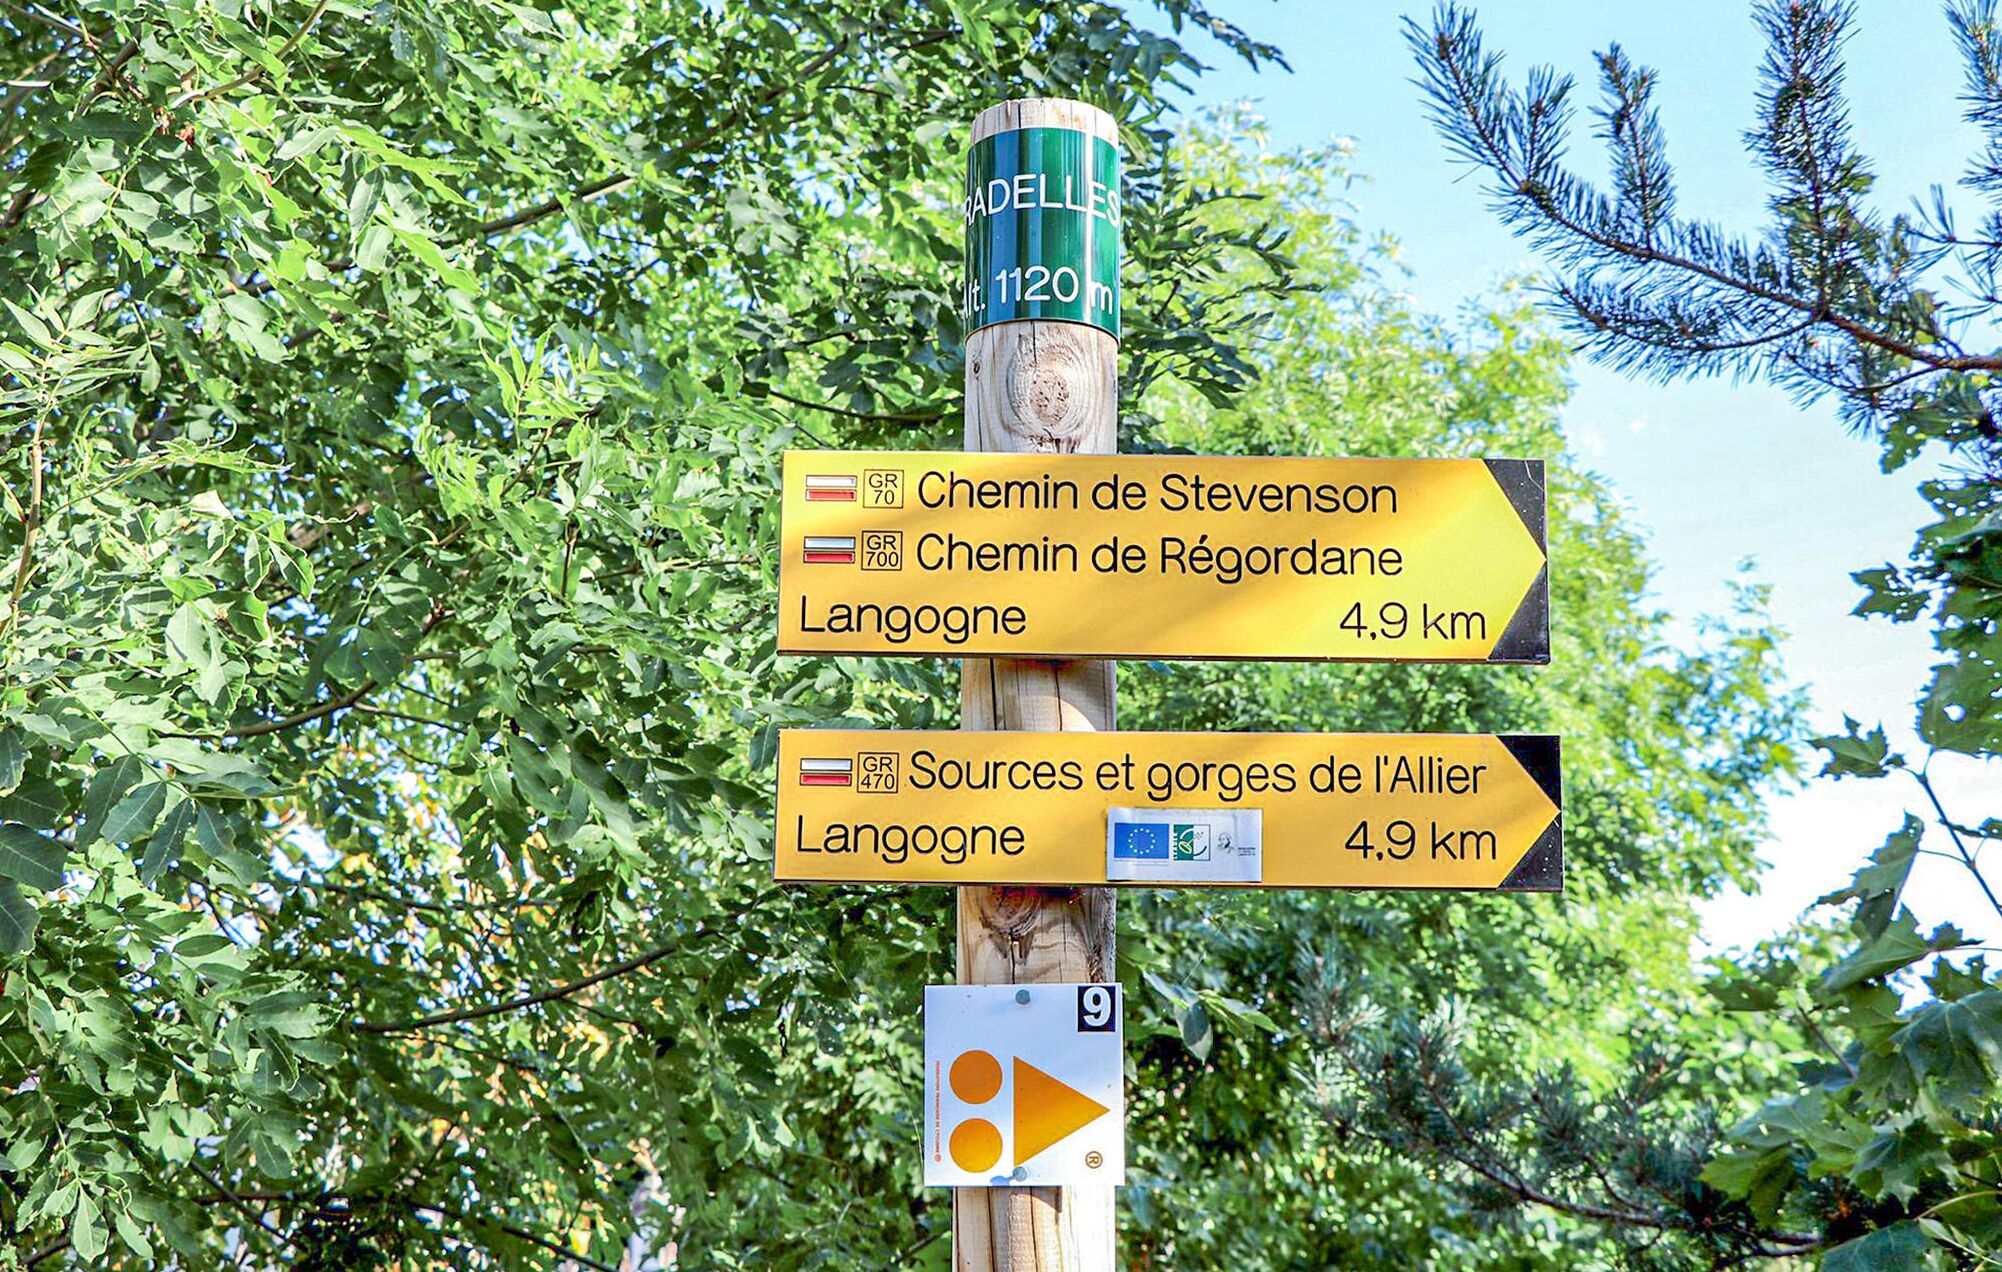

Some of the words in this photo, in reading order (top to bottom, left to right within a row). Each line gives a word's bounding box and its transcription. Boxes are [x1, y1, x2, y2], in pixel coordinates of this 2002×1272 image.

[995, 265, 1079, 304] 1120
[1090, 279, 1113, 315] m
[868, 472, 898, 489] GR
[874, 490, 895, 505] 70
[918, 471, 1078, 510] Chemin
[1091, 473, 1147, 511] de
[1160, 473, 1397, 514] Stevenson
[866, 534, 897, 551] GR
[866, 551, 899, 568] 700
[916, 533, 1078, 572] Chemin
[1091, 536, 1147, 574] de
[1161, 534, 1403, 585] Régordane
[800, 595, 1026, 645] Langogne
[1339, 602, 1408, 641] 4,9
[1423, 603, 1486, 640] km
[860, 773, 895, 790] 470
[862, 756, 893, 773] GR
[908, 750, 1083, 790] Sources
[1096, 753, 1135, 791] et
[1147, 762, 1297, 803] gorges
[1309, 755, 1362, 794] de
[1375, 755, 1487, 795] l'Allier
[797, 814, 1025, 865] Langogne
[1344, 820, 1416, 861] 4,9
[1431, 821, 1496, 860] km
[1083, 987, 1111, 1027] 9
